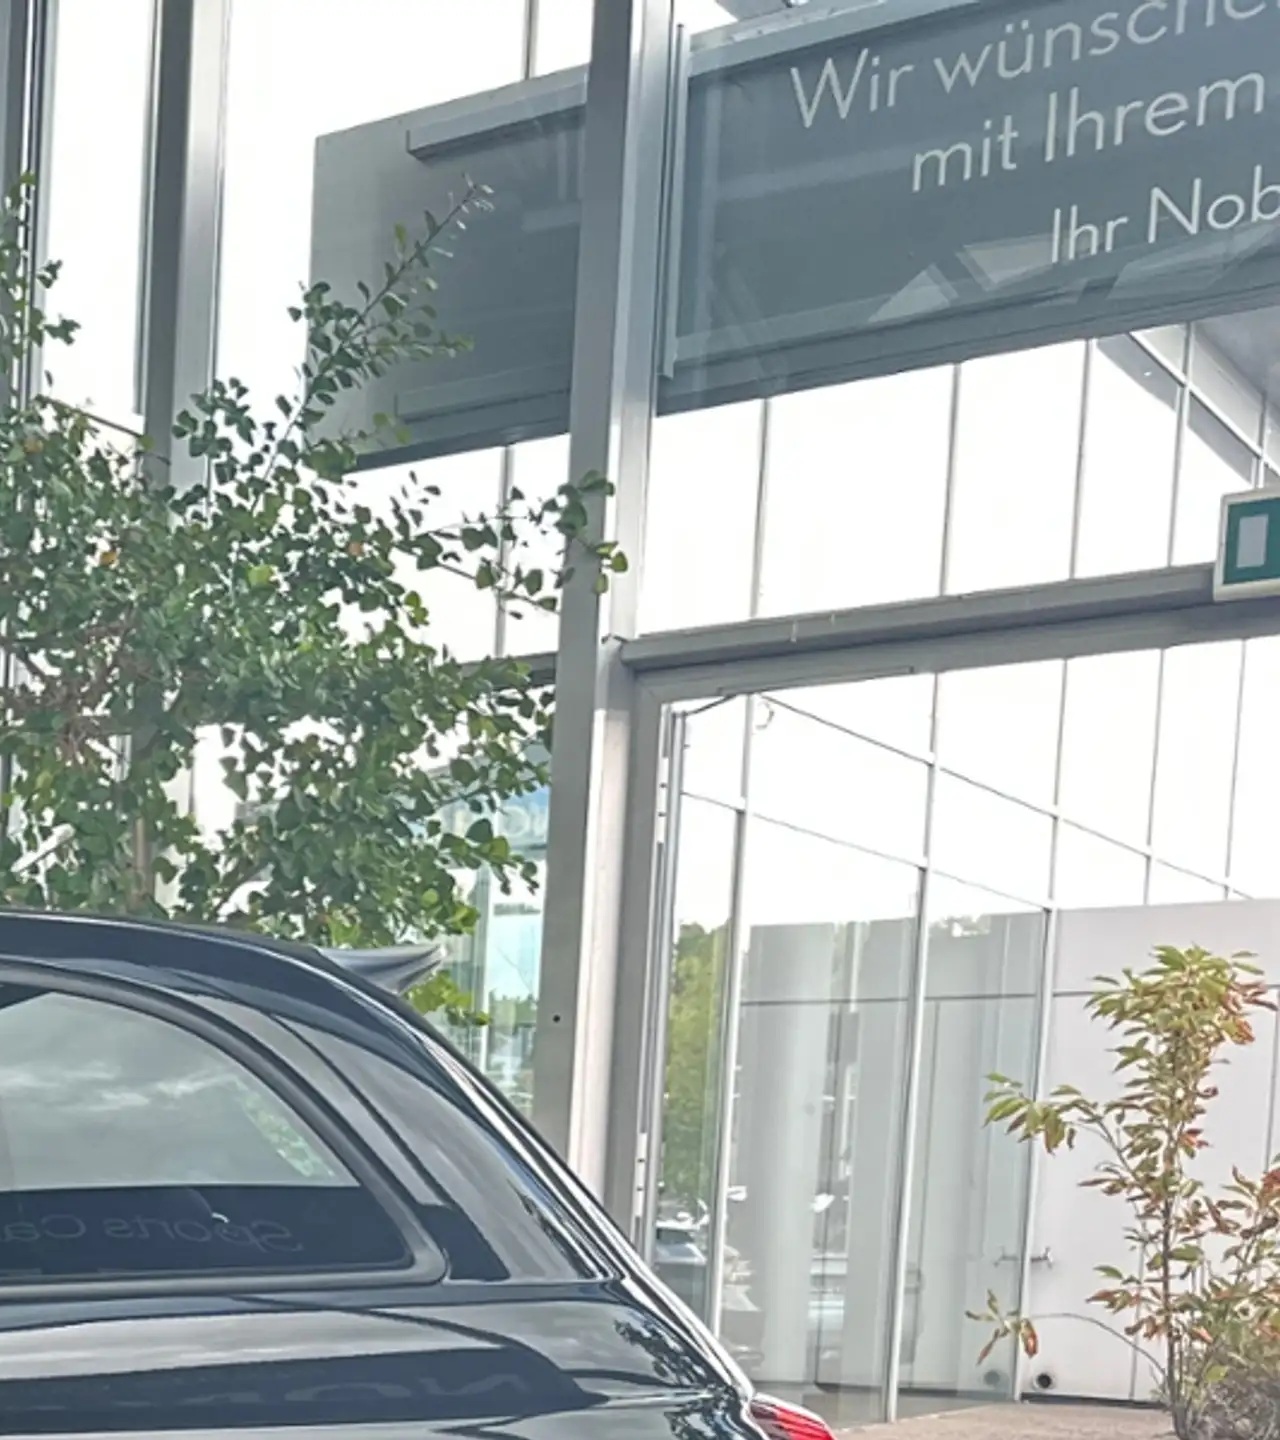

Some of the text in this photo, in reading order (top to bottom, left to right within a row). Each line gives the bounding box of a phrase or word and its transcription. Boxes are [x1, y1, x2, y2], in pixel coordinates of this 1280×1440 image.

[790, 0, 1280, 129] Wir wünsc
[912, 72, 1266, 192] mit Ihrem
[1051, 204, 1130, 264] Ihr
